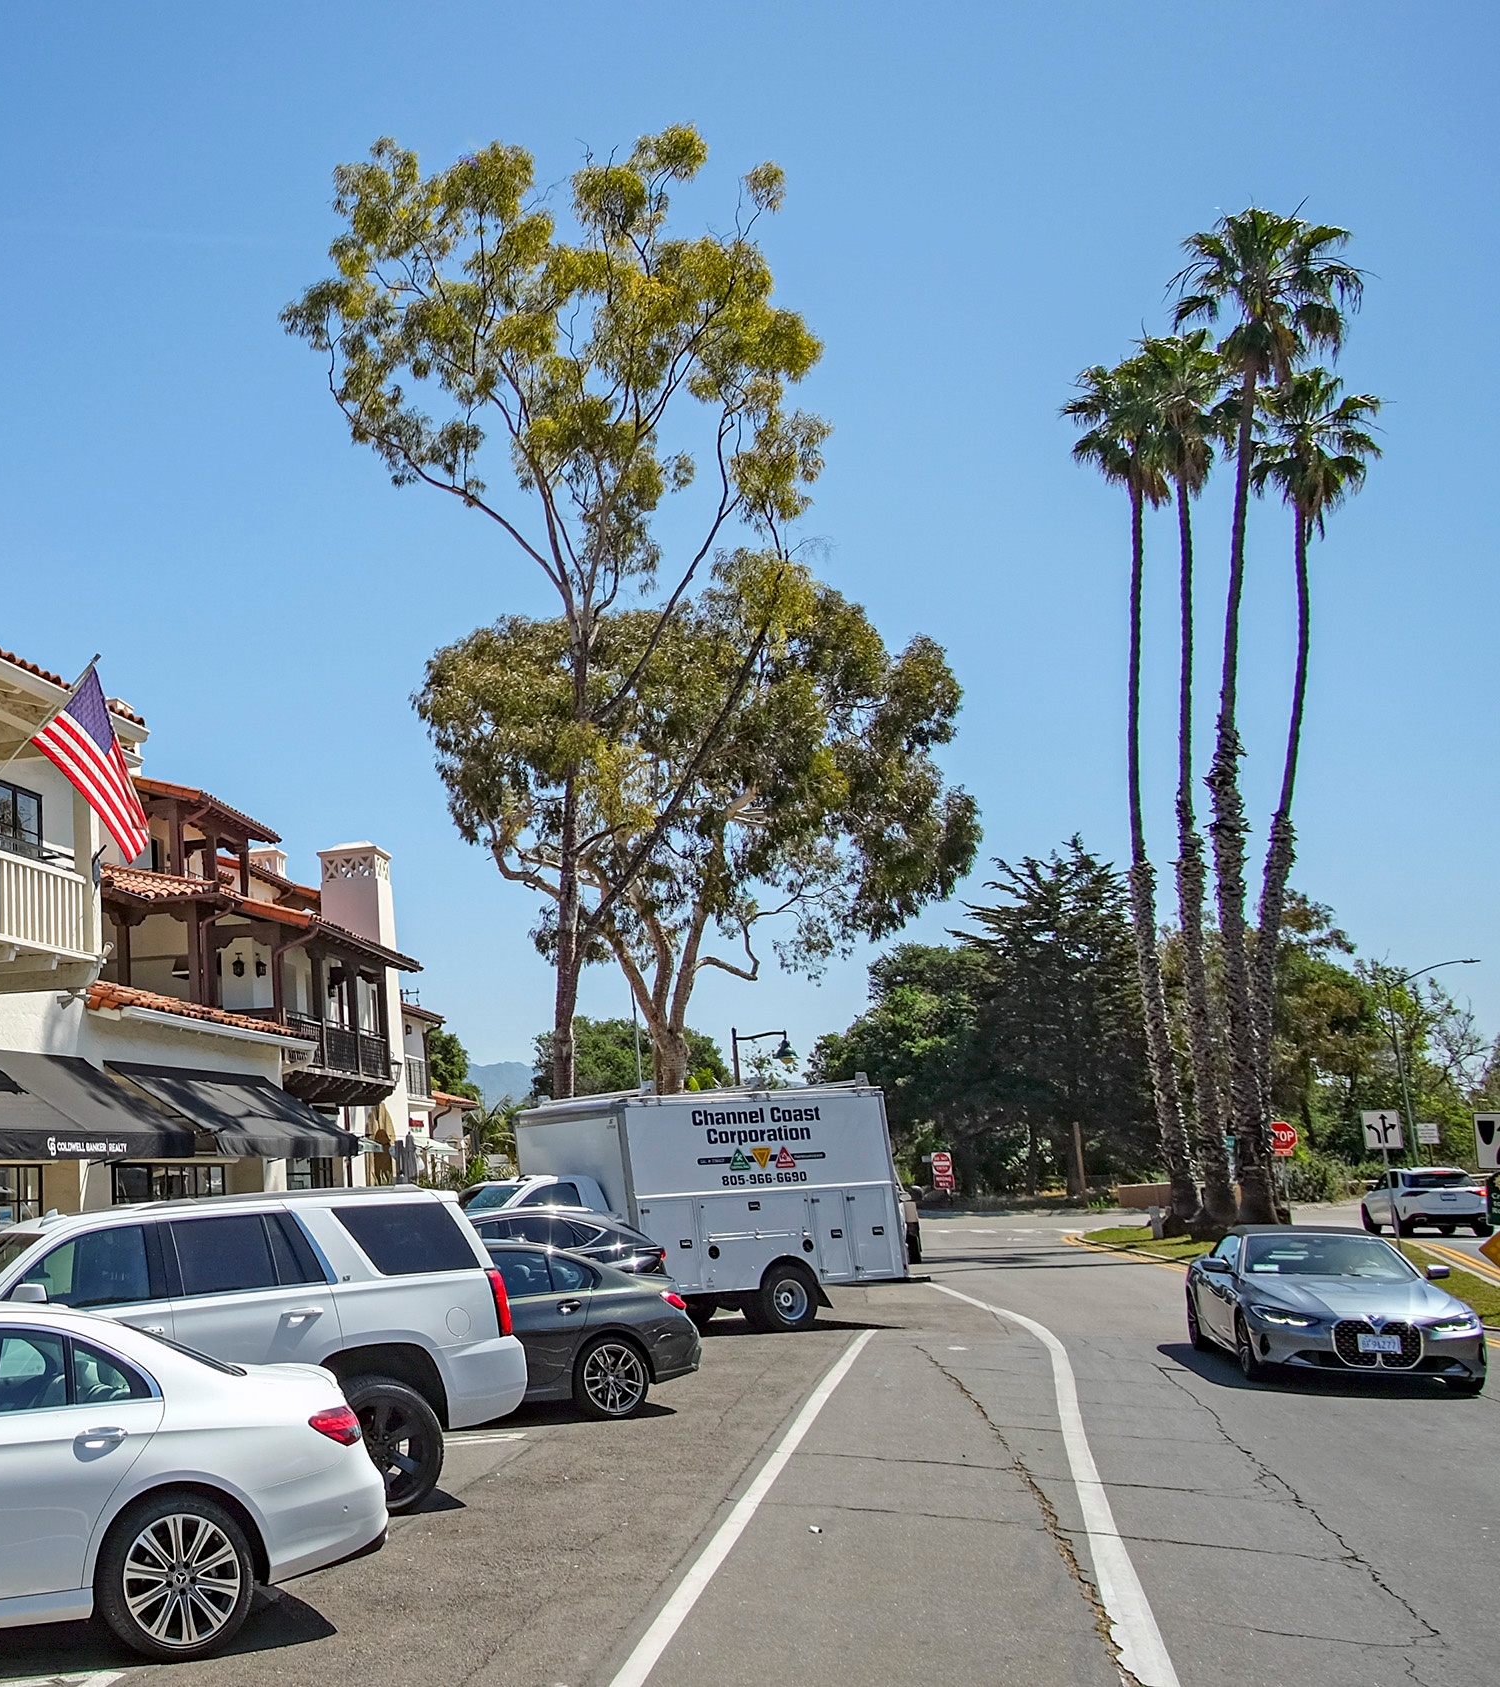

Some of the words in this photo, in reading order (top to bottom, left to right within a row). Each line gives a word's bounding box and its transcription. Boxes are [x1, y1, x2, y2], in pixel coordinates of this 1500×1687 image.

[691, 1107, 765, 1127] Channel
[770, 1105, 821, 1123] Coast
[706, 1125, 811, 1146] Corporation
[57, 1141, 86, 1152] COLDWELL
[86, 1142, 107, 1153] BANKER
[108, 1142, 127, 1153] REALTY
[721, 1171, 808, 1187] 805-966-6690
